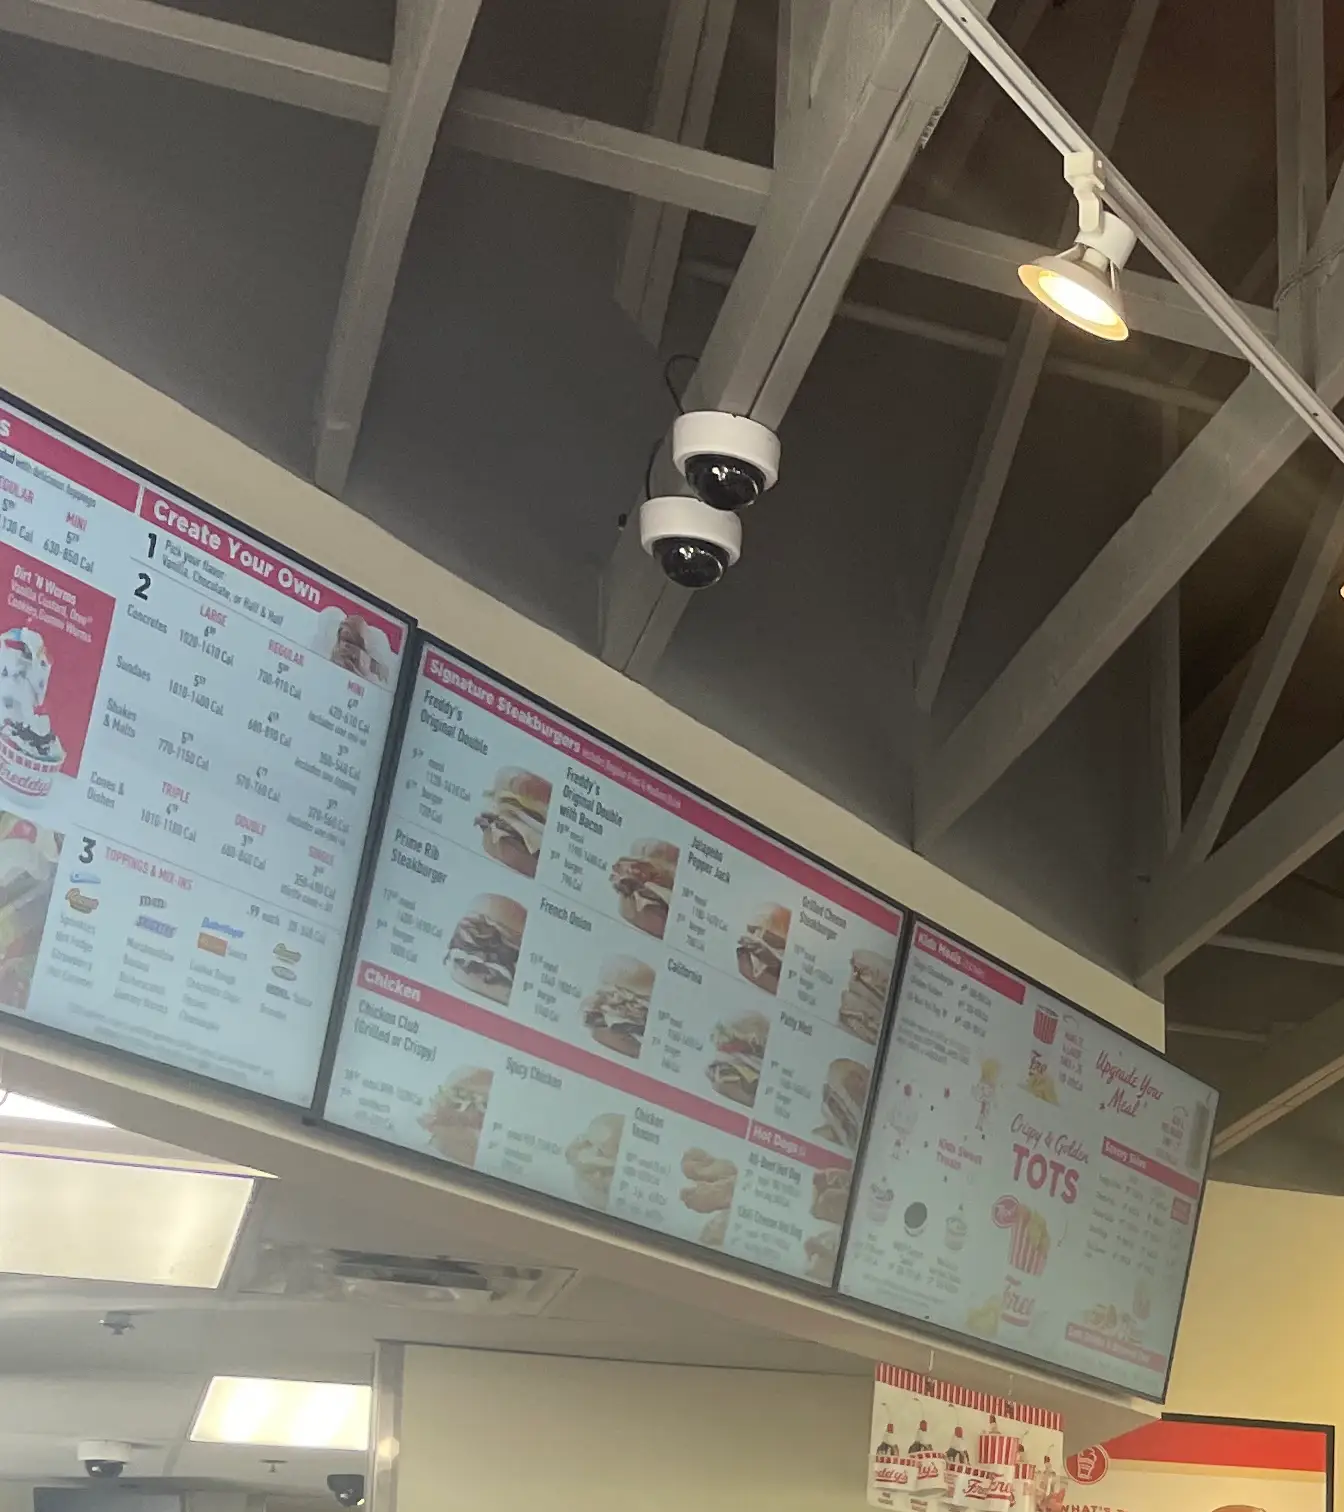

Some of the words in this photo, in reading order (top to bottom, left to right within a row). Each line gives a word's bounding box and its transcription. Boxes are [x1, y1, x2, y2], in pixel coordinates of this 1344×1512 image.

[147, 532, 158, 558] 1
[153, 500, 221, 551] Create
[227, 537, 275, 579] Your
[278, 567, 321, 606] Own
[133, 573, 151, 601] 2
[126, 604, 169, 635] Concretes
[200, 604, 229, 628] LARGE
[424, 689, 464, 722] Freddy's
[430, 658, 496, 706] Signature
[496, 696, 582, 753] Steakburgers
[457, 728, 489, 755] Double
[162, 781, 191, 805] TRIPLE
[78, 837, 97, 865] 3
[393, 828, 424, 858] Prime
[424, 842, 441, 862] Rib
[390, 848, 449, 886] Steakburger
[539, 897, 568, 922] French
[363, 967, 422, 1003] Chicken
[357, 998, 397, 1028] Chicken
[396, 1014, 420, 1035] Club
[1095, 1050, 1138, 1089] Upgrade
[1137, 1071, 1165, 1101] Your
[1107, 1087, 1142, 1118] Meal
[752, 1125, 773, 1145] Hot
[772, 1133, 800, 1156] Dogs
[1010, 1113, 1043, 1148] Crispy
[1054, 1133, 1090, 1165] Golden
[1012, 1143, 1080, 1205] TOTS
